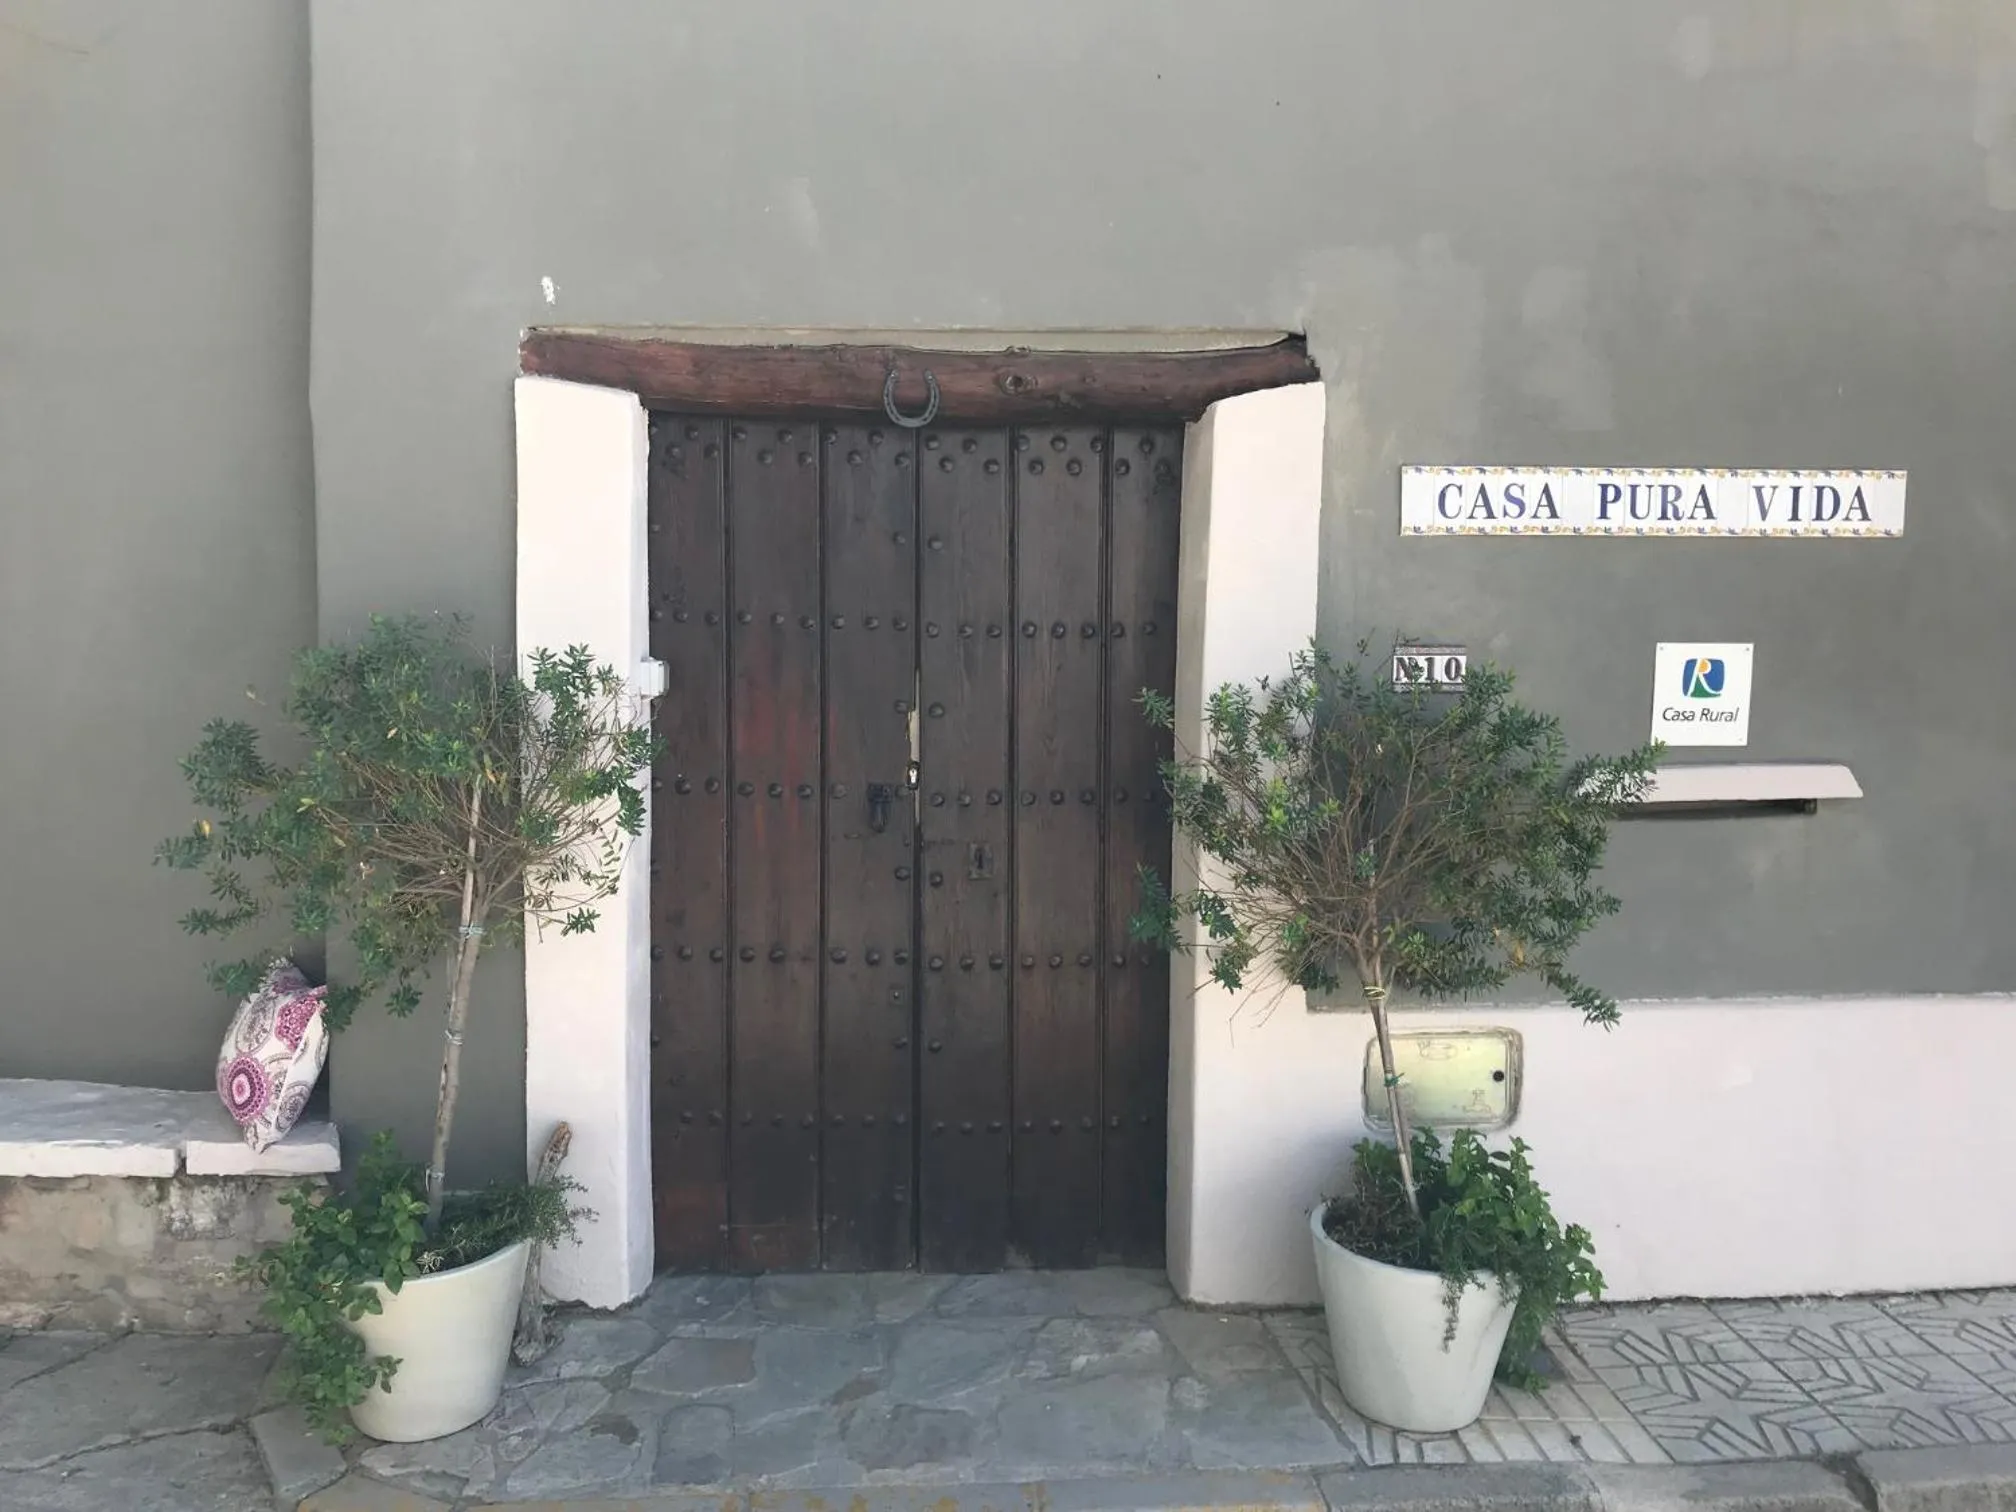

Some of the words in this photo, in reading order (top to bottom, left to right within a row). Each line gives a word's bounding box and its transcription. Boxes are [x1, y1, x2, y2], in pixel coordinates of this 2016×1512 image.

[1437, 482, 1560, 520] CASA
[1597, 483, 1717, 521] PURA
[1753, 485, 1872, 522] VIDA
[1662, 707, 1696, 721] Casa
[1699, 707, 1740, 722] Rural
